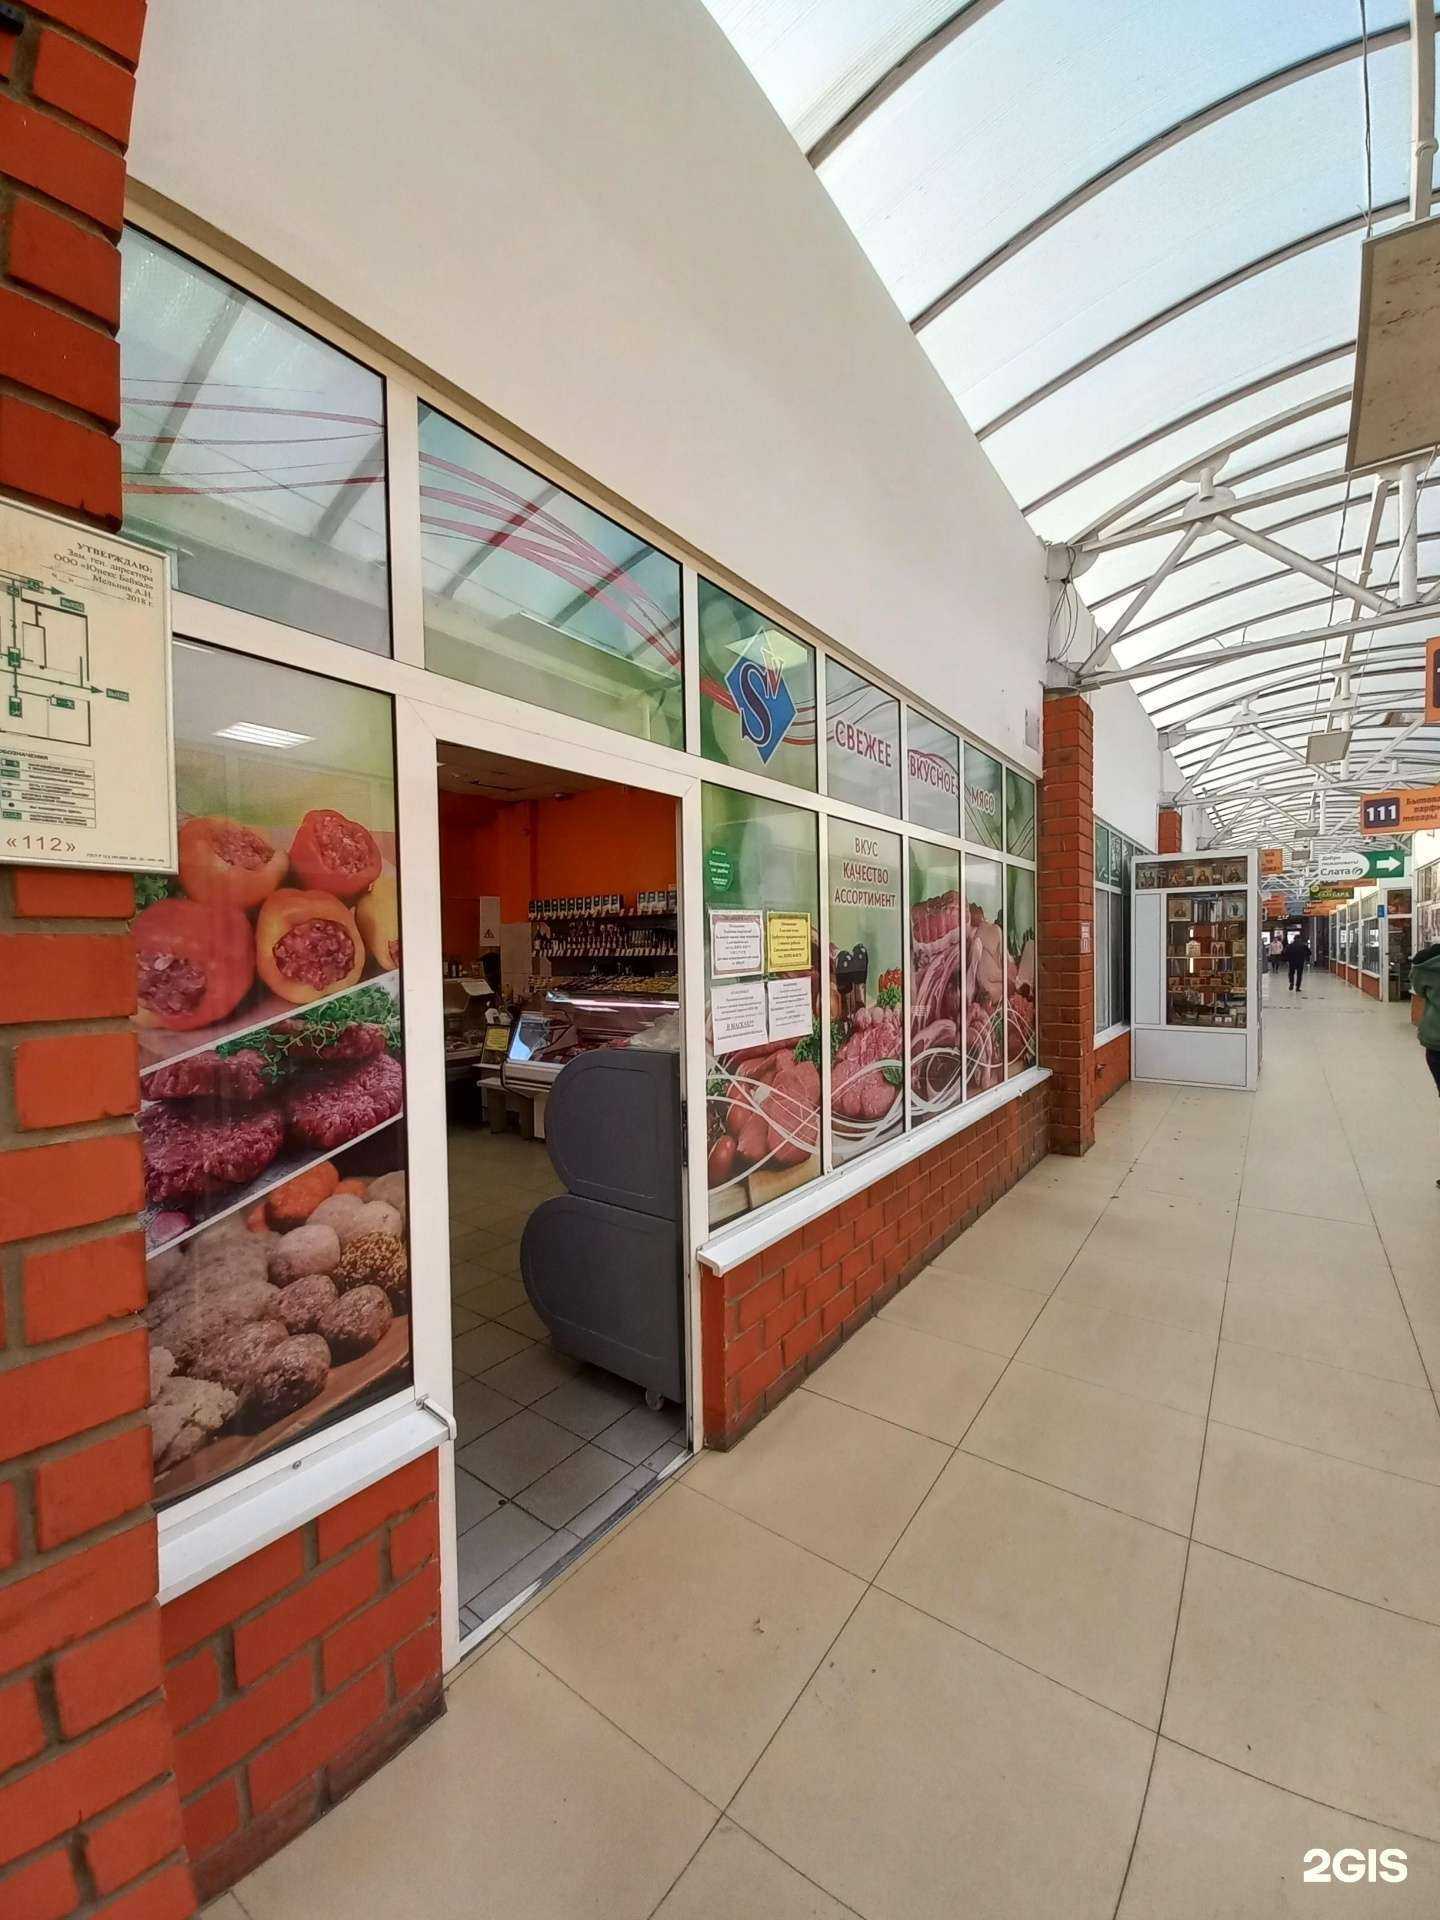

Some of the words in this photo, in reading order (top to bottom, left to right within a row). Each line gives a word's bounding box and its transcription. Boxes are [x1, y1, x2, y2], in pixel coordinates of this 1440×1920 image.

[54, 553, 79, 567] ООО
[77, 542, 152, 573] УТВЕРЖДАЮ:
[835, 720, 892, 767] СВЕЖЕЕ
[910, 755, 956, 795] ВКУСНОЕ
[970, 786, 995, 813] МЯСО
[1366, 805, 1396, 821] 111
[855, 837, 878, 857] ВКУС
[843, 862, 889, 884] КАЧЕСТВО
[1320, 868, 1351, 876] Слата
[834, 888, 896, 907] АССОРТИМЕНТ
